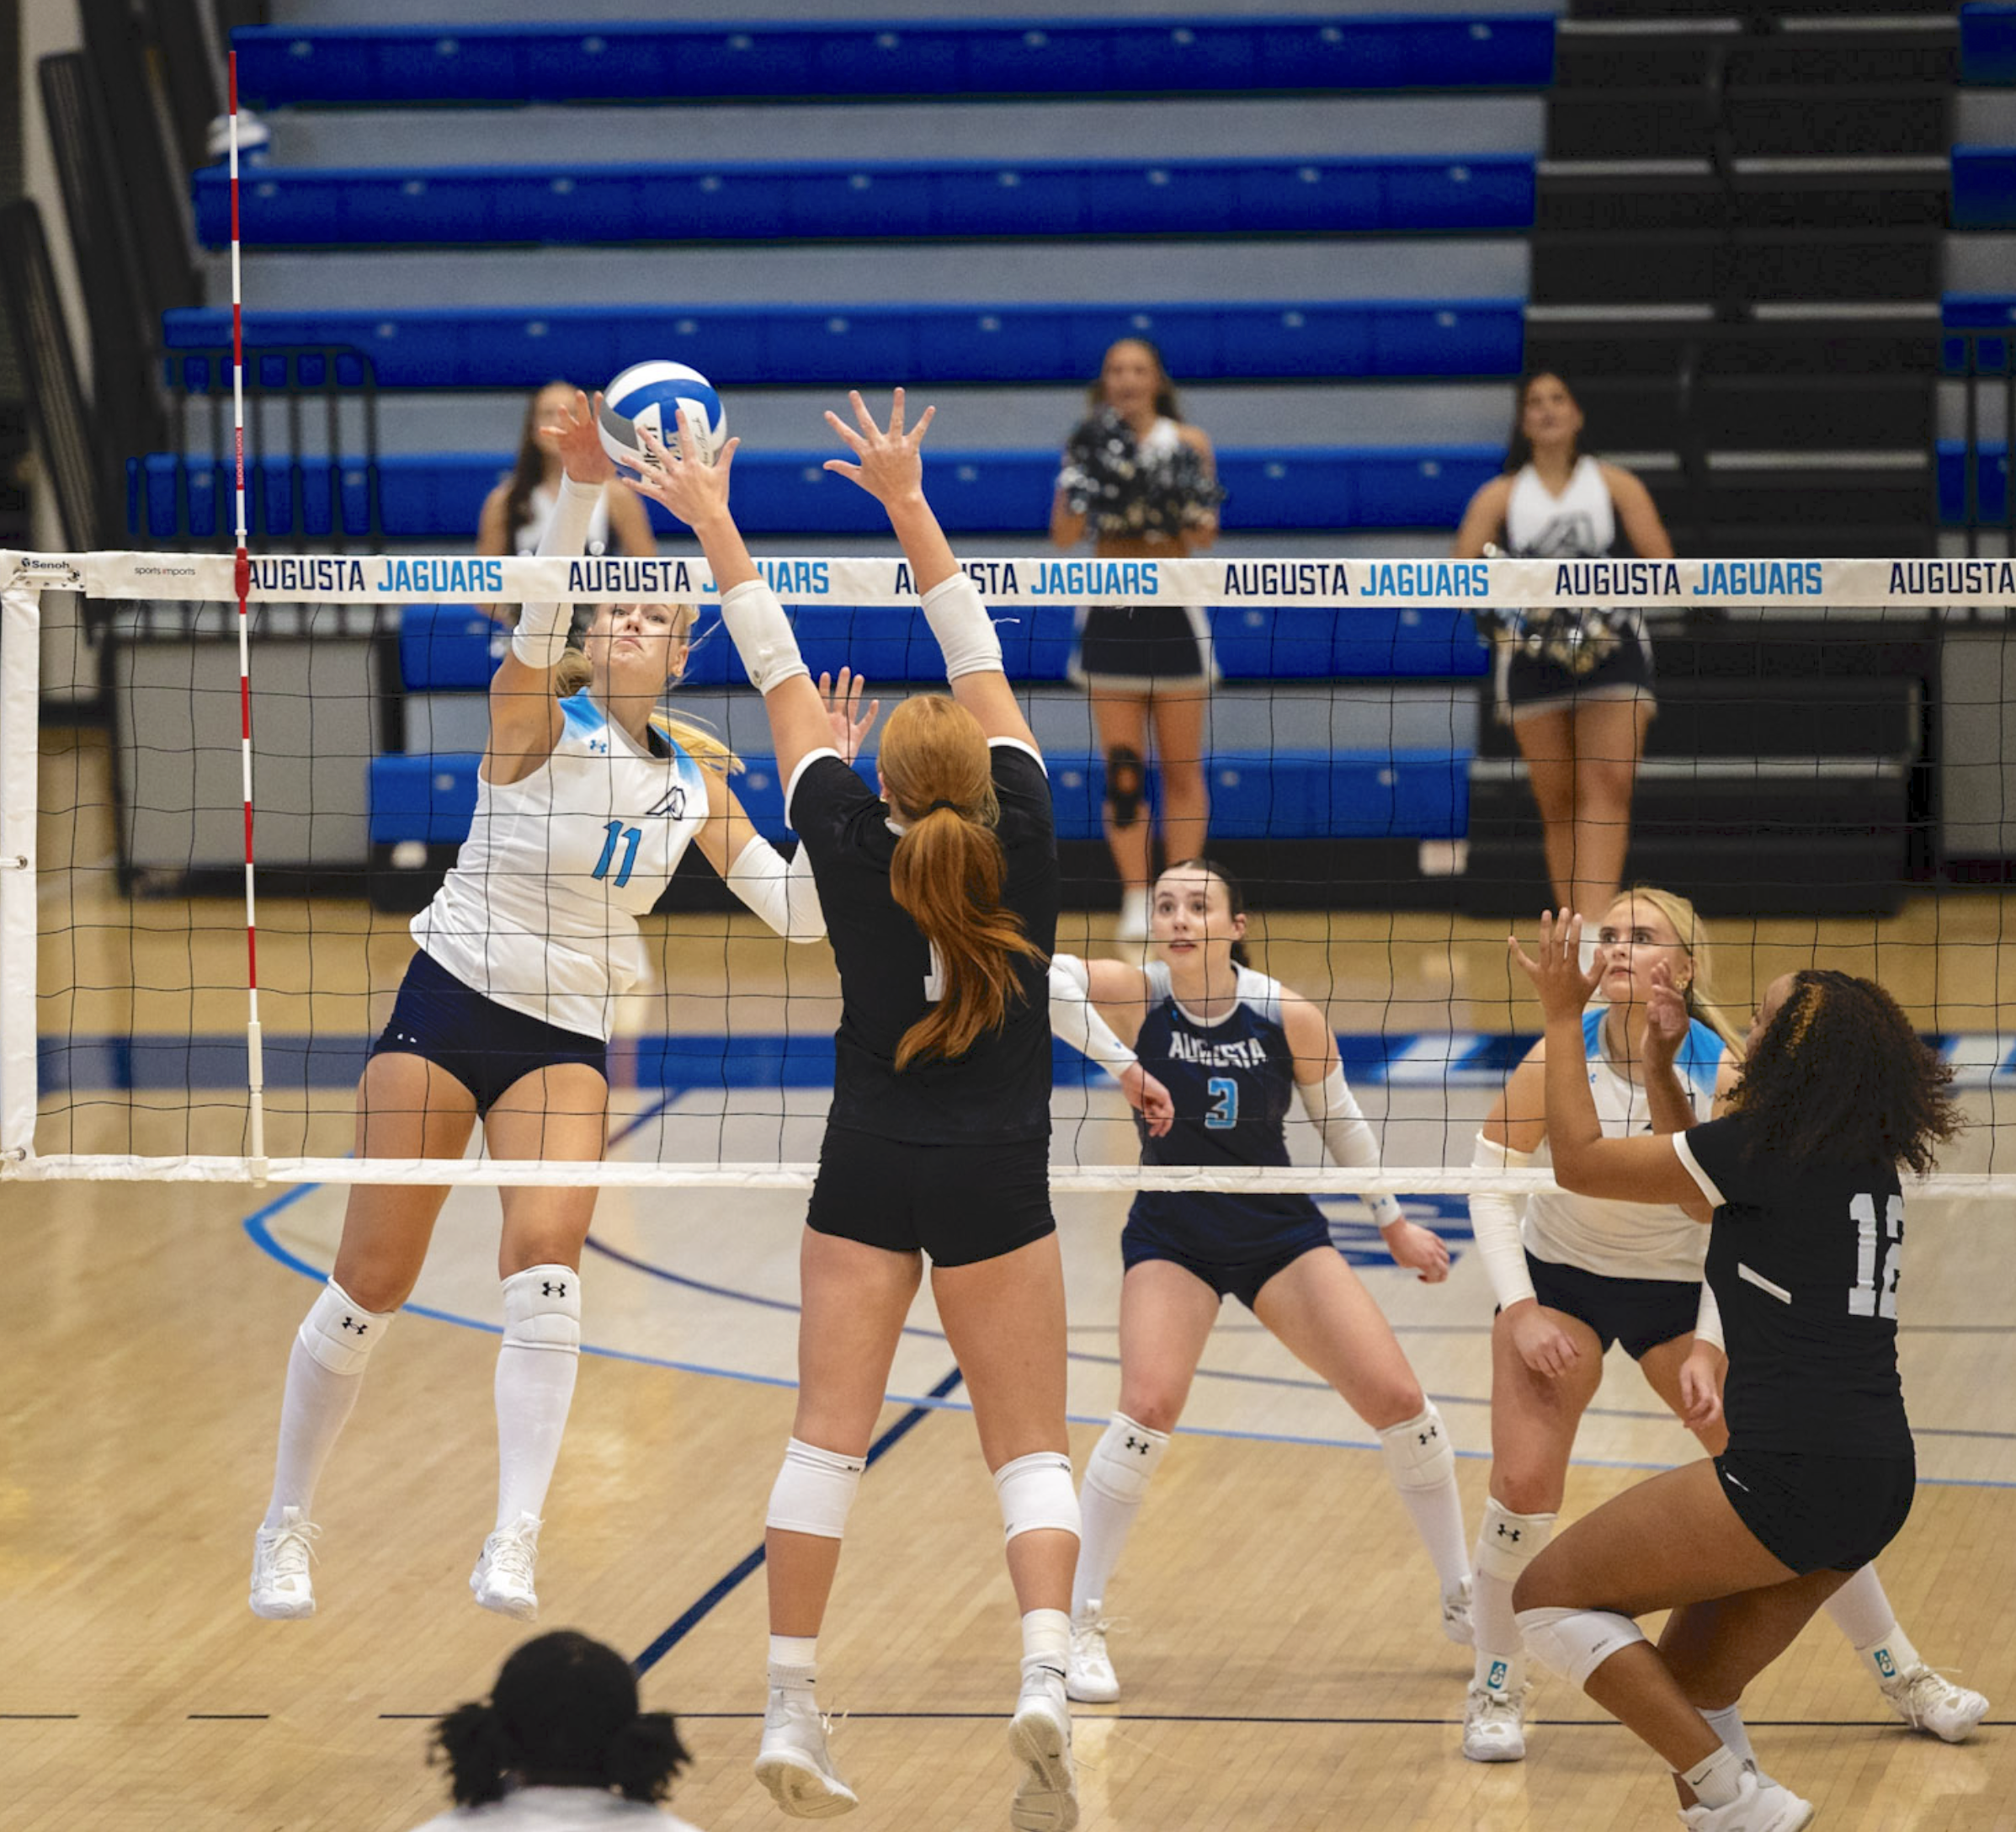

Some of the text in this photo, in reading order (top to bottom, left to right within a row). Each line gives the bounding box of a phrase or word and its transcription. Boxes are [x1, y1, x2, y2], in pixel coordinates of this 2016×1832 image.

[32, 560, 70, 569] Senoh
[135, 567, 161, 575] sports
[248, 559, 503, 593] AUGUSTA JAGUARS
[568, 560, 691, 593] AUGUSTA
[894, 562, 1158, 596] ASTA JAGUARS
[1224, 563, 1489, 597] AUGUSTA JAGUARS
[1555, 562, 1823, 596] AUGUSTA JAGUARS
[1888, 562, 2016, 595] AUGUSTA
[591, 820, 642, 888] 11
[1168, 1030, 1268, 1069] AUGUSTA
[1205, 1077, 1239, 1130] 3
